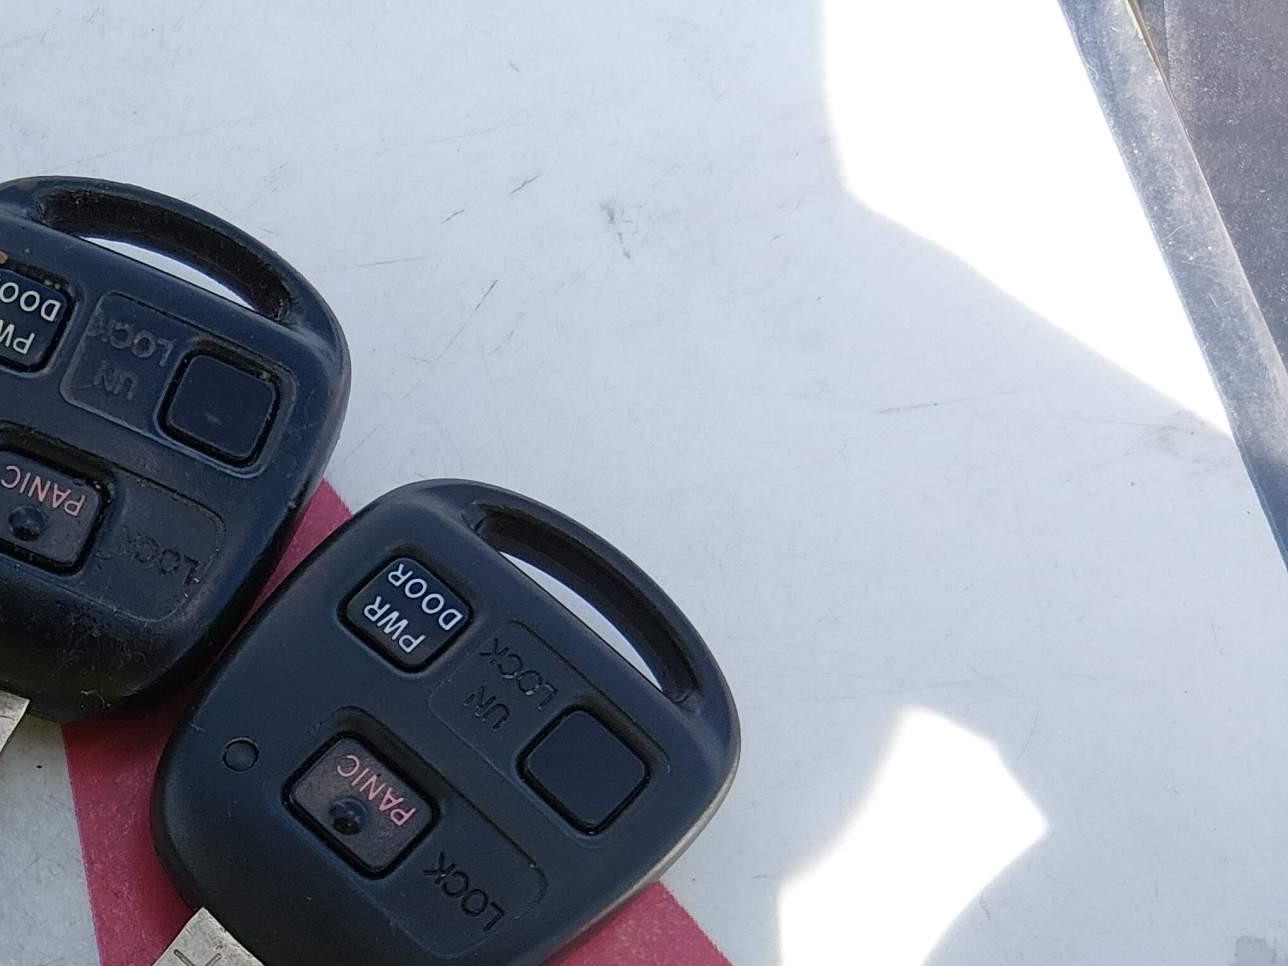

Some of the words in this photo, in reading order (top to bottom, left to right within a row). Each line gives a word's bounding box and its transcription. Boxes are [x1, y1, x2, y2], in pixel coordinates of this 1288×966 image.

[0, 464, 87, 517] PANIC
[119, 532, 204, 588] LOC
[363, 596, 425, 654] PWR
[387, 563, 463, 631] DOOR
[478, 637, 560, 711] LOCK
[464, 685, 511, 730] UN
[336, 755, 417, 827] PANIC
[424, 852, 504, 932] LOCK
